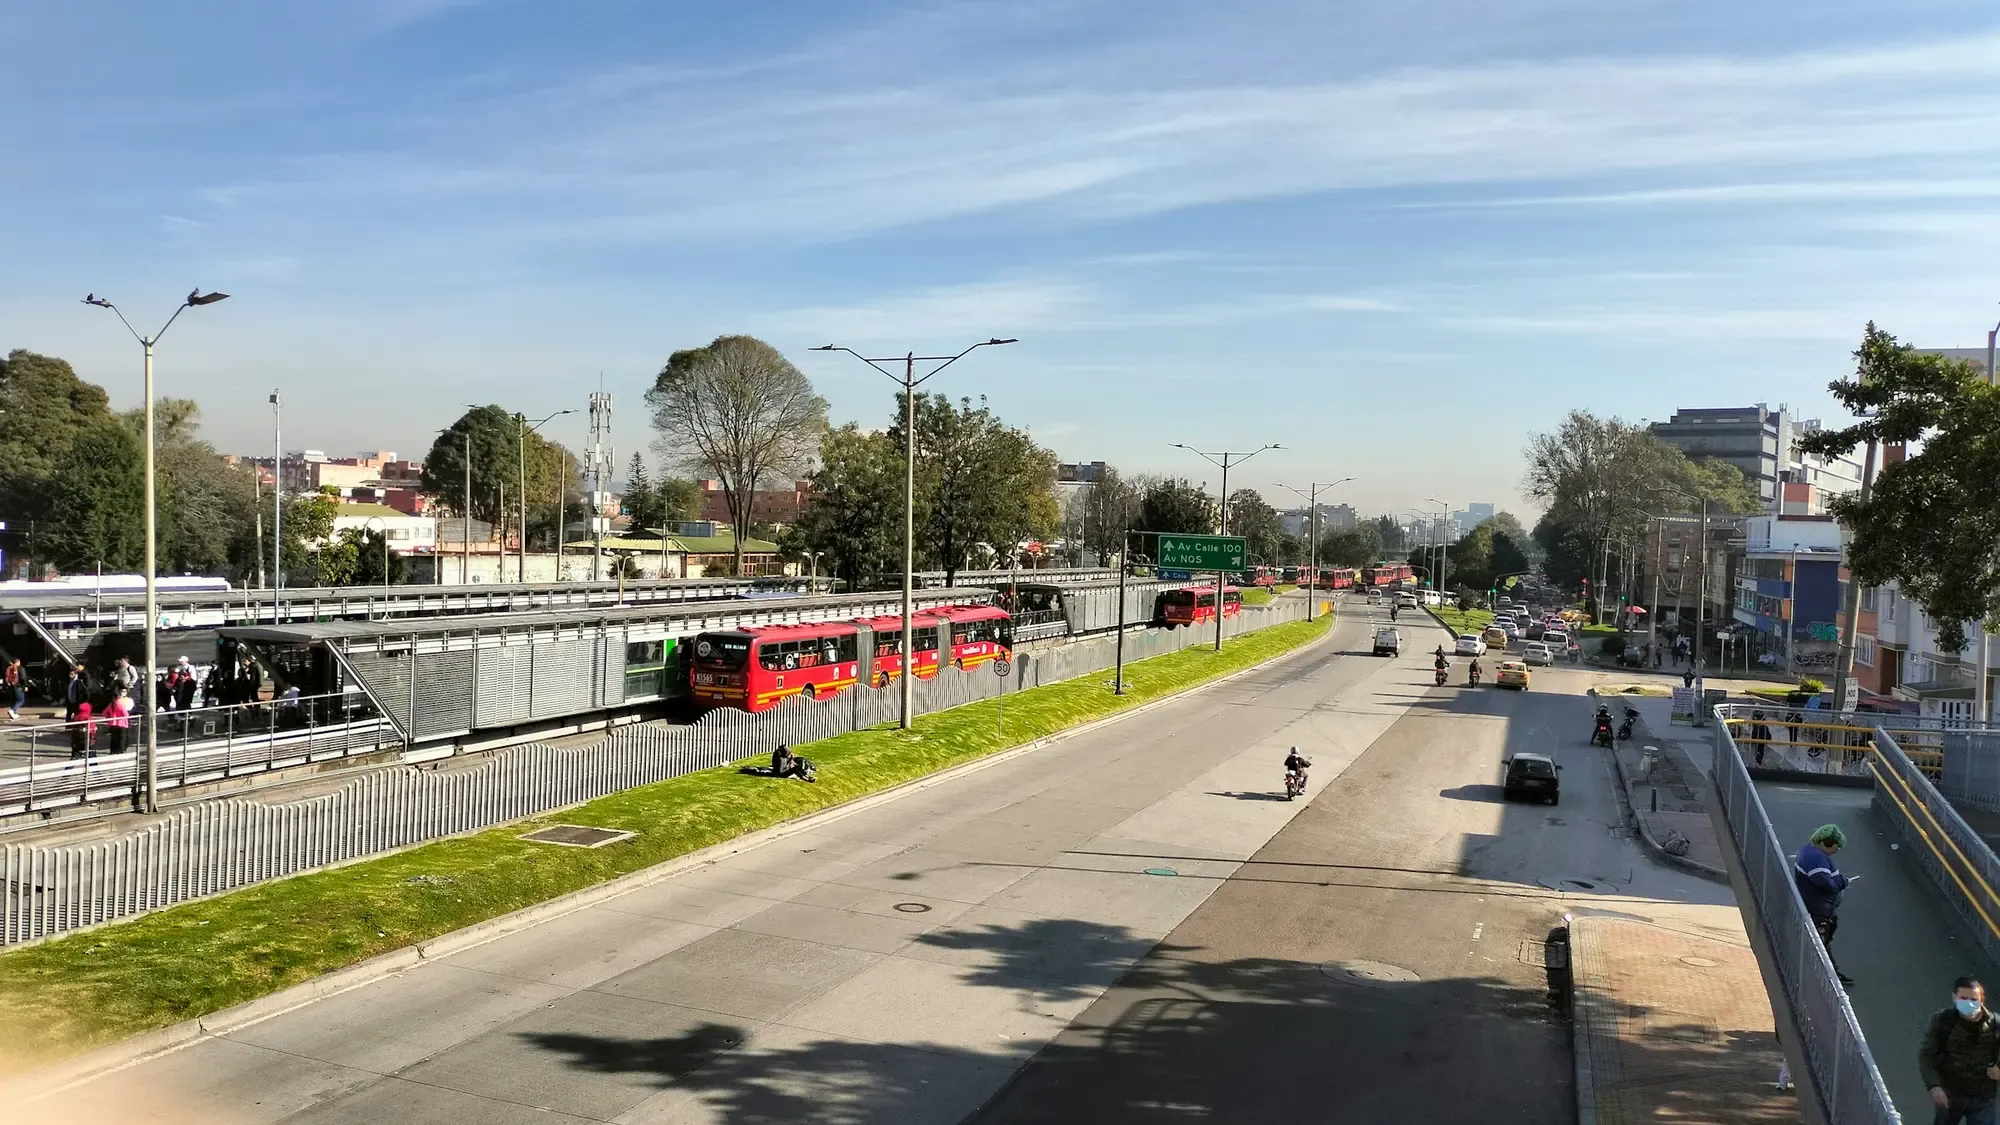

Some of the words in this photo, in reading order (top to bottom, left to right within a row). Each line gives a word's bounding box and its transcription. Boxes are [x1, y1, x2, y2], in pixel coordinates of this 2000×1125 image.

[1178, 542, 1191, 551] Av
[1195, 543, 1219, 552] Calle
[1223, 544, 1241, 553] 100
[1163, 554, 1176, 562] Av
[1180, 555, 1202, 564] NQS
[997, 663, 1008, 673] 50
[696, 673, 713, 682] K1565
